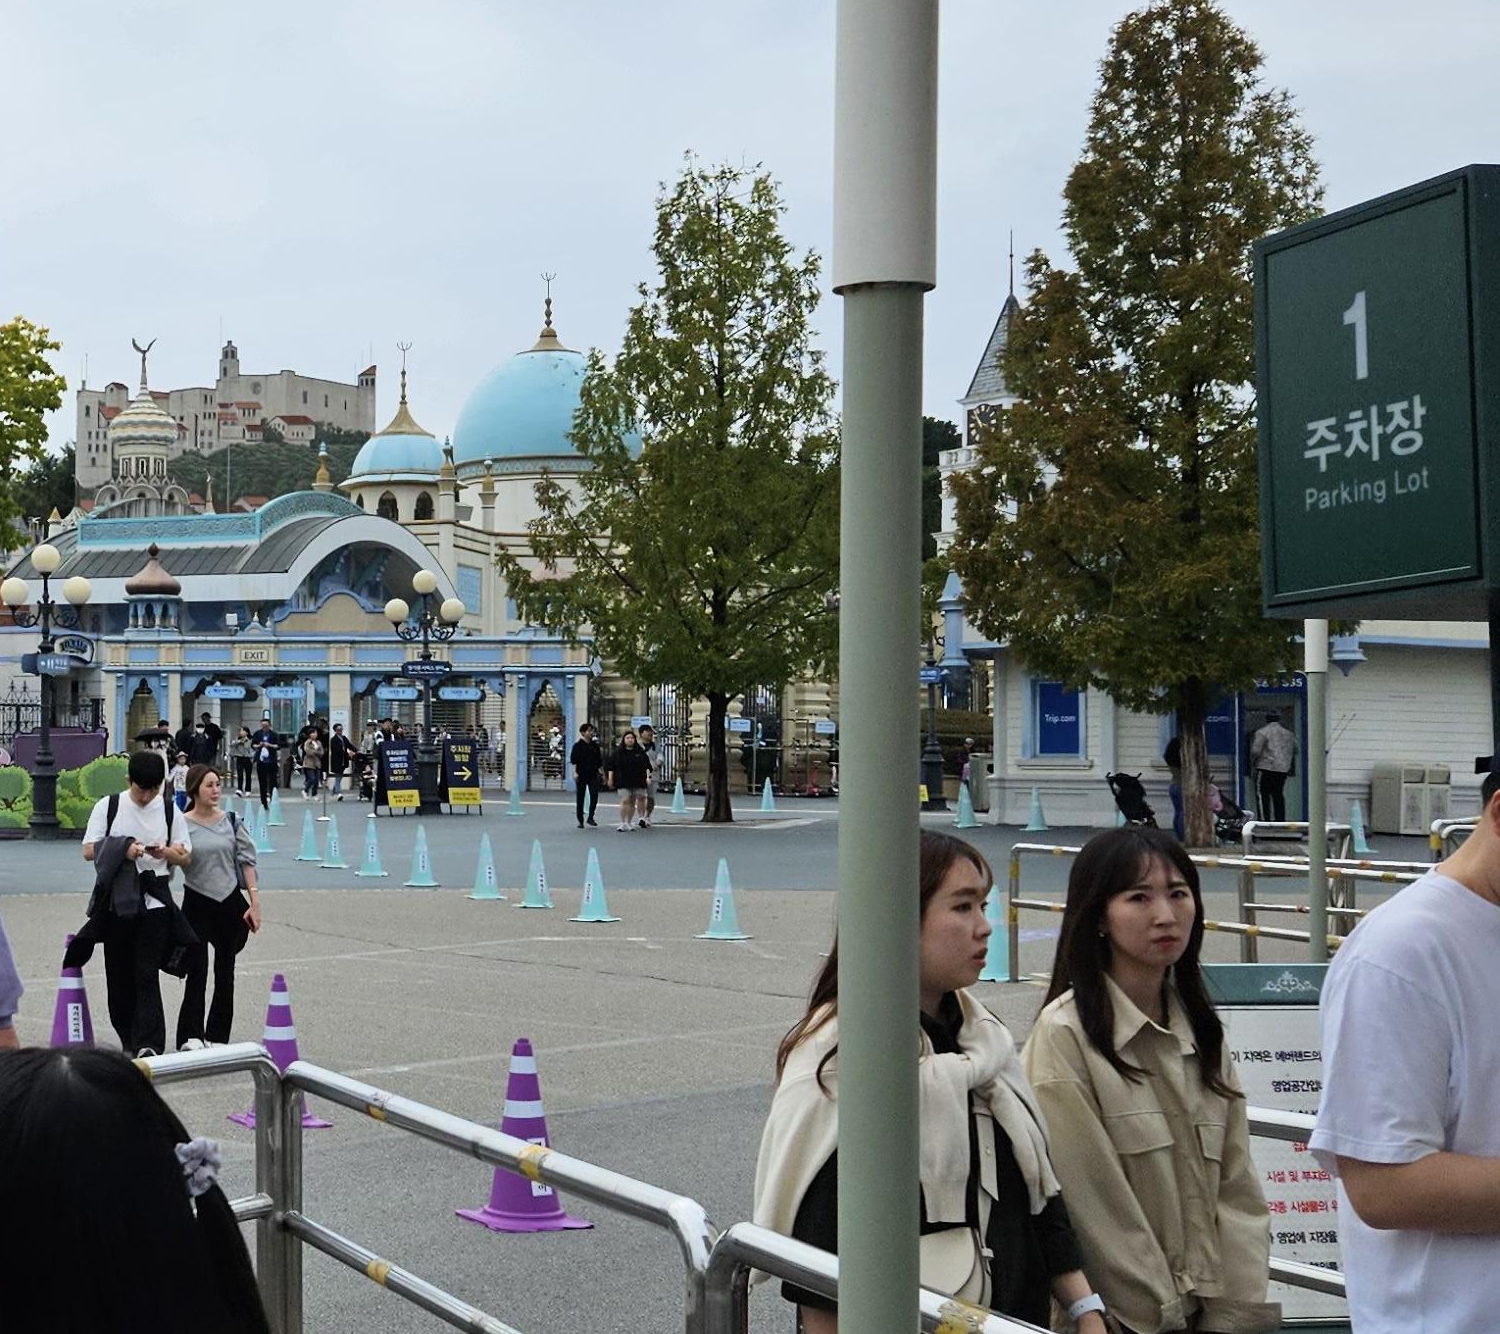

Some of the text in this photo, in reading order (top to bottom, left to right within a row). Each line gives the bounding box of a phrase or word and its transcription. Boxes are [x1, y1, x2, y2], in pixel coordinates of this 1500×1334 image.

[1343, 290, 1369, 380] 1
[1303, 394, 1427, 472] 주차장
[1305, 466, 1429, 512] Parking Lot
[244, 651, 265, 660] EXIT
[1044, 713, 1076, 724] Trip.com
[1243, 1050, 1273, 1063] 지역은
[1274, 1050, 1322, 1063] 에버랜드의
[1276, 1230, 1338, 1244] 영업에 지장을
